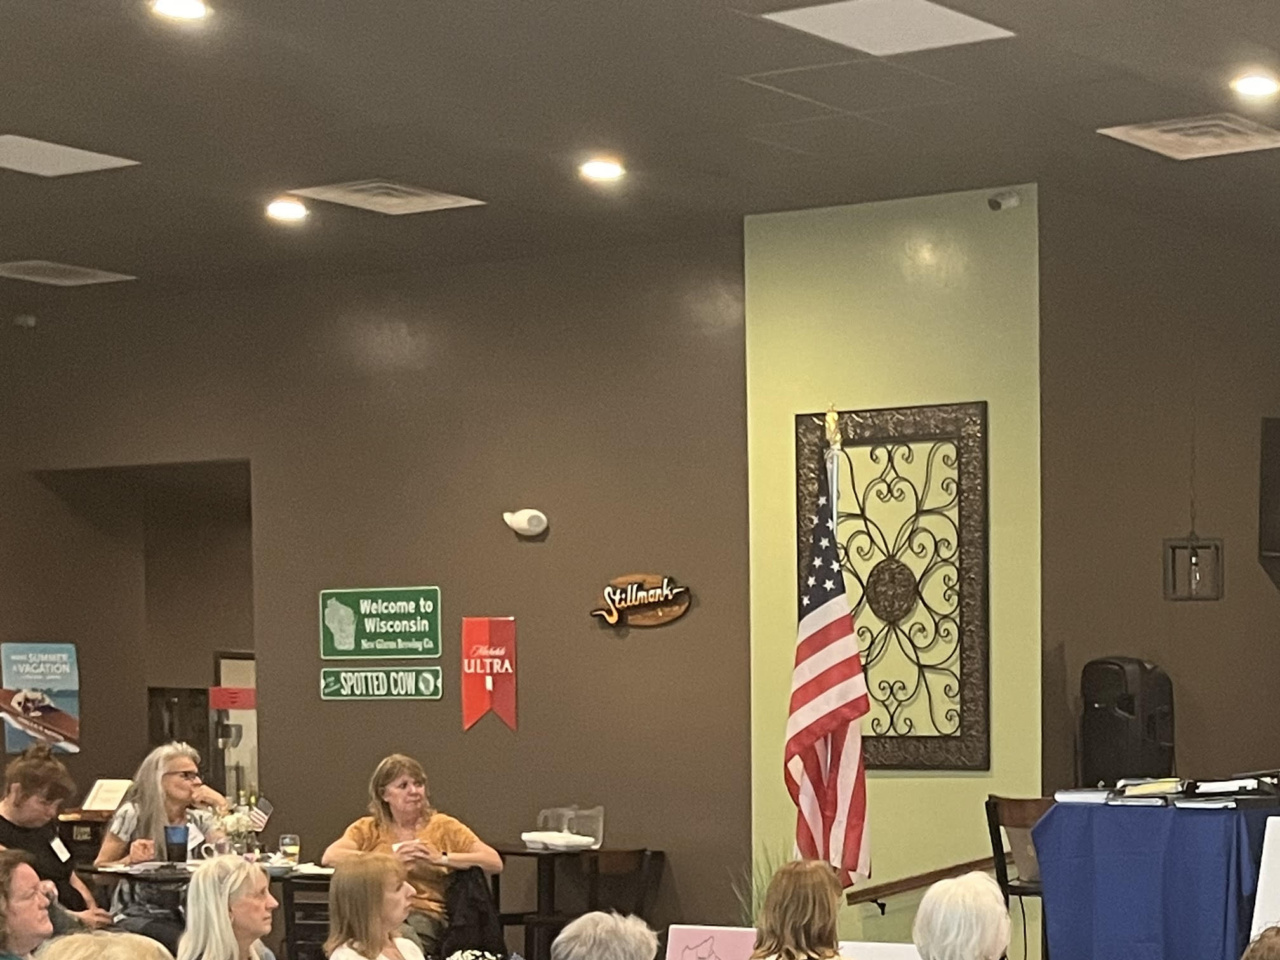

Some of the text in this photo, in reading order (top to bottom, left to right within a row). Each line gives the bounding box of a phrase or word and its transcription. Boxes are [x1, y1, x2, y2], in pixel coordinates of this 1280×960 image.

[360, 597, 433, 614] Welcome to
[592, 578, 685, 624] Stillmank
[364, 616, 429, 633] Wisconsin
[28, 653, 68, 663] SUMMER
[464, 658, 513, 673] ULTRA
[18, 663, 71, 673] VACATION
[341, 672, 388, 695] SPOTTED
[390, 671, 416, 695] COW
